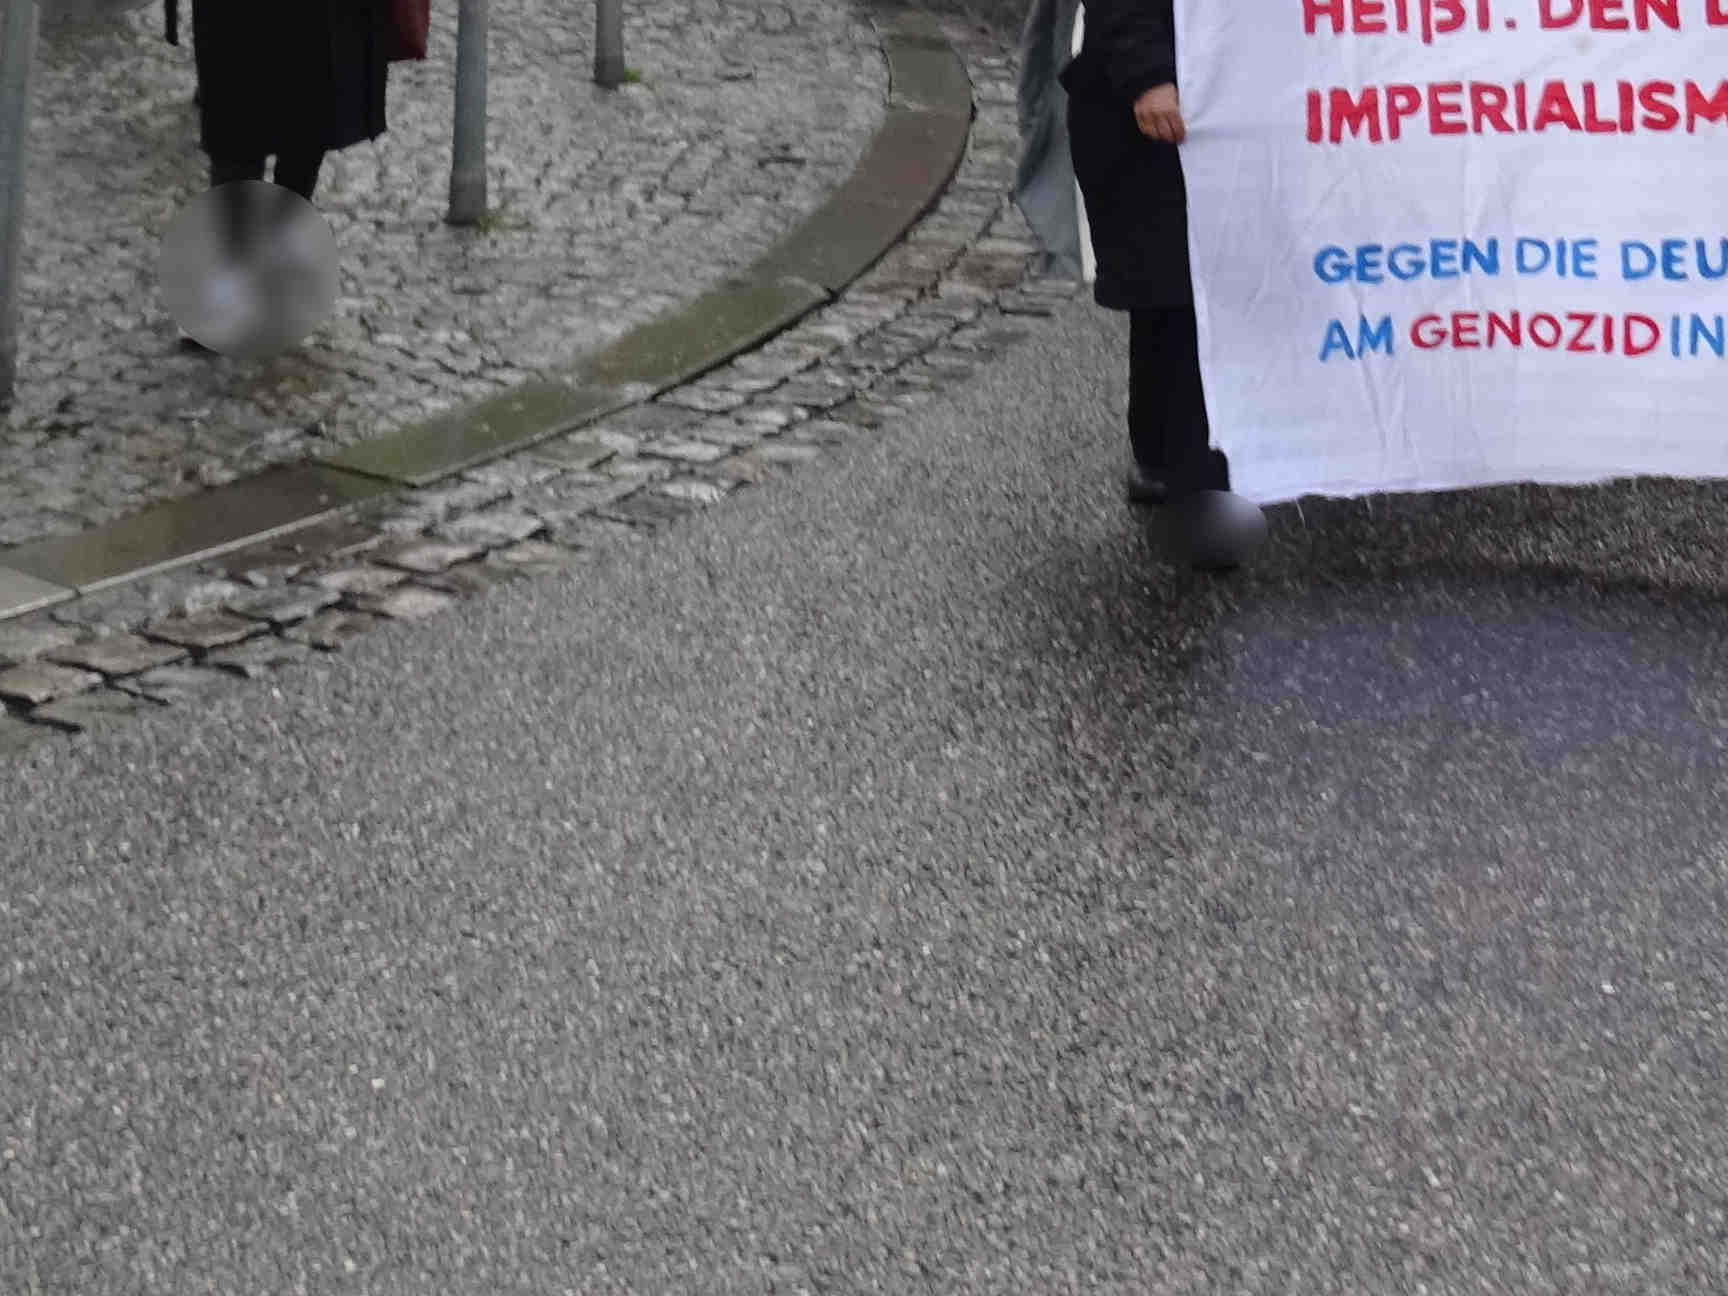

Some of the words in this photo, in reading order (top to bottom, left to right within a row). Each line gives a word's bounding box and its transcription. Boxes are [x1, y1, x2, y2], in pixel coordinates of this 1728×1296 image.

[1312, 237, 1502, 287] GEGEN
[1513, 237, 1598, 281] DIE
[1317, 313, 1395, 363] AM
[1409, 310, 1661, 358] GENOZID
[1670, 313, 1727, 359] IN
